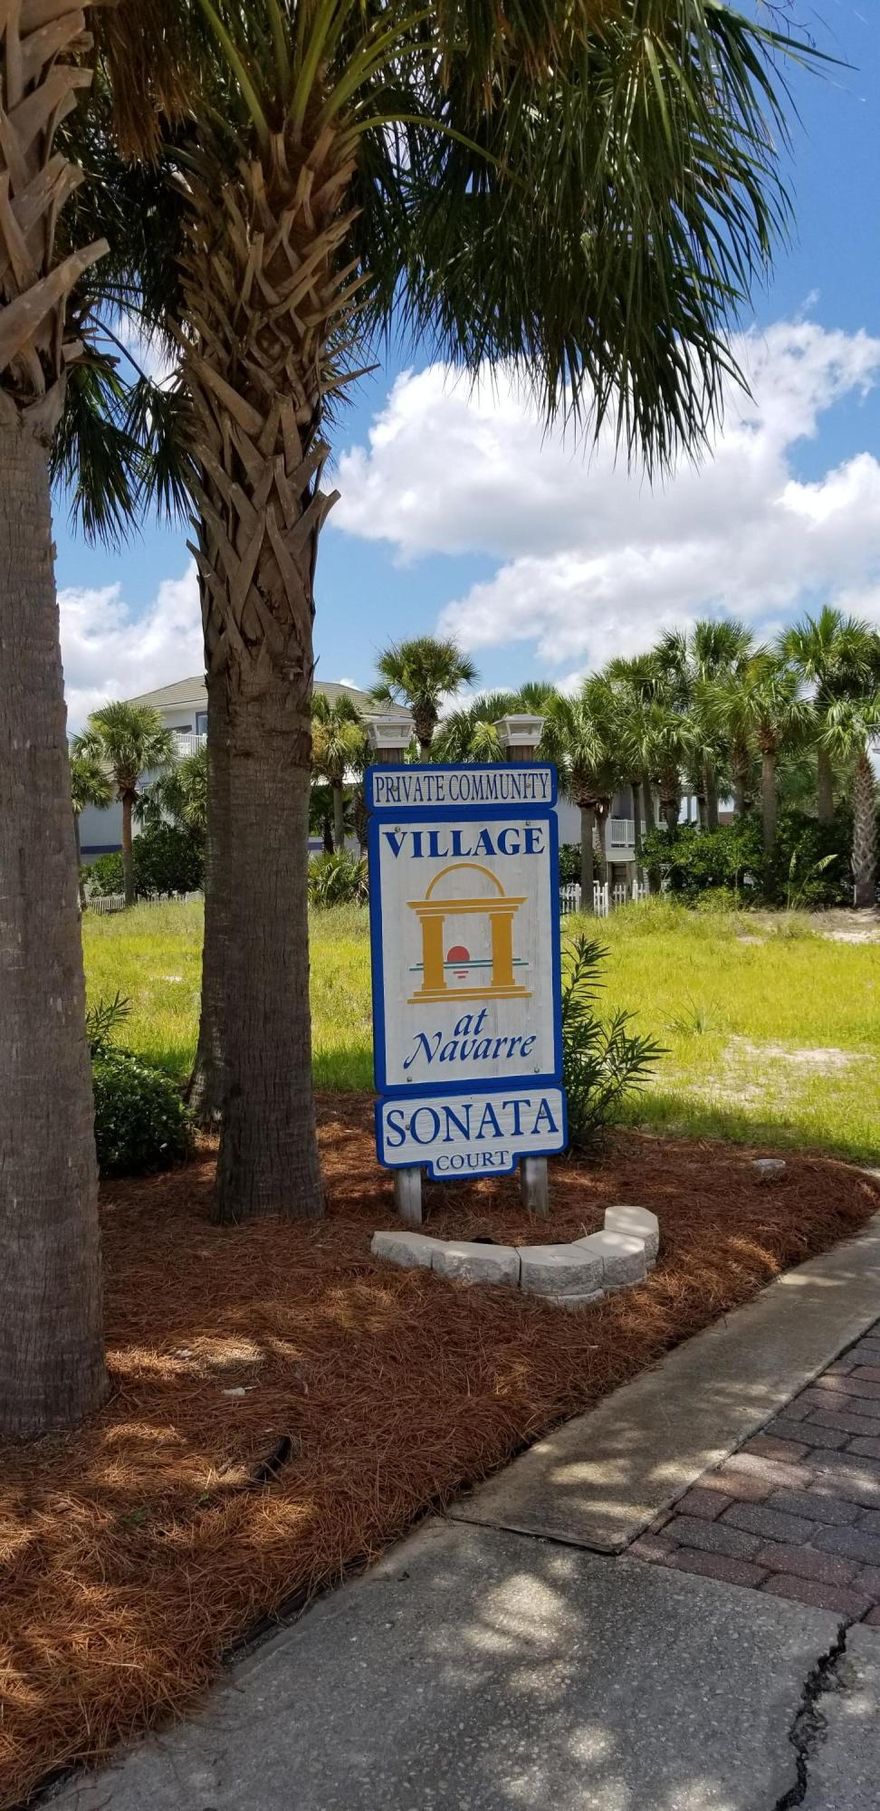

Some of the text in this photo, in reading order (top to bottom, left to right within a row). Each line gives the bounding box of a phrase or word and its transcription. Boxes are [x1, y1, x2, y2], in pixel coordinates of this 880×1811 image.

[375, 773, 549, 803] PRIVATE COMMUNITY
[382, 827, 545, 859] VILLAGE
[453, 1008, 490, 1037] at
[403, 1031, 537, 1069] Navarre
[386, 1098, 559, 1148] SONATA
[435, 1150, 510, 1171] COURT
